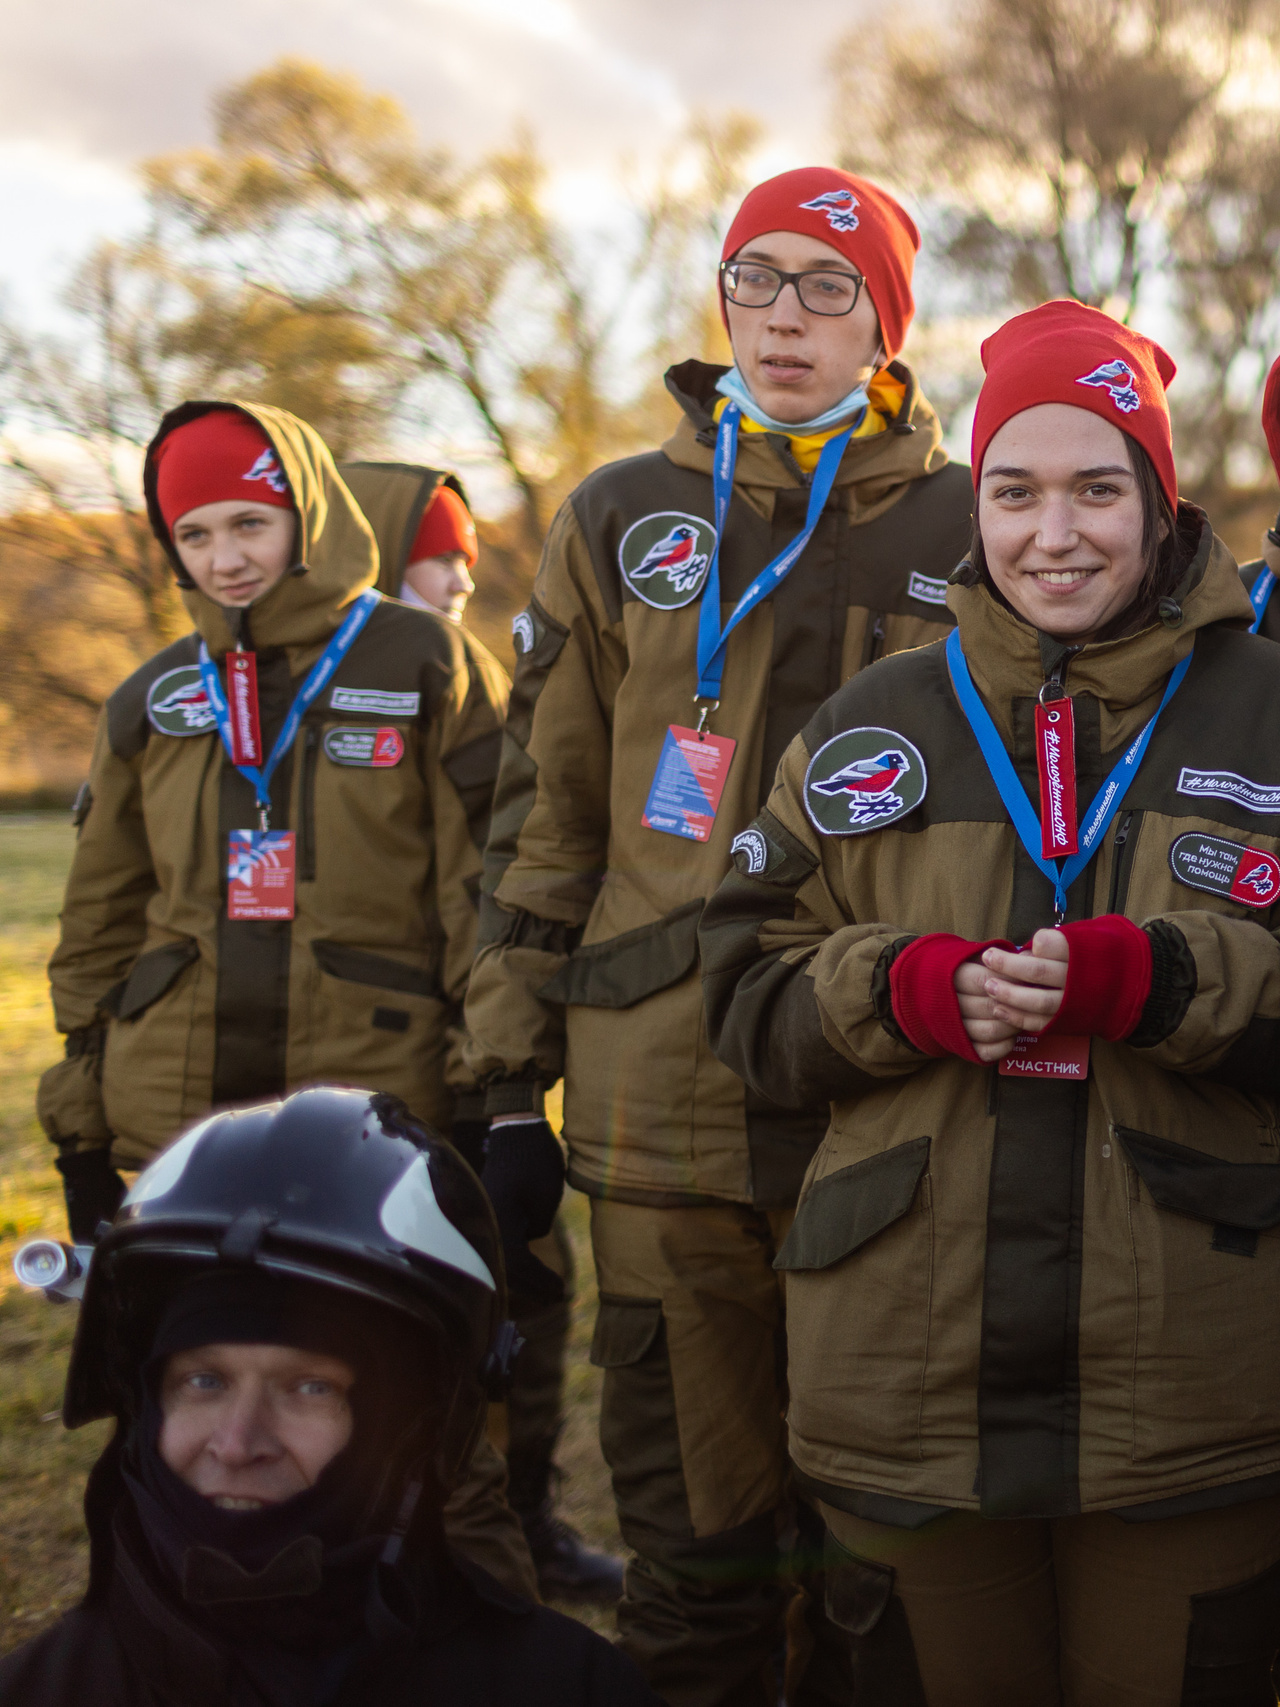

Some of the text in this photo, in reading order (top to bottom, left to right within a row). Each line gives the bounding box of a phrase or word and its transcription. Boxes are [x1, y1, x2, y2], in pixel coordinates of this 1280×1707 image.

[1178, 851, 1234, 873] где нужна
[1199, 844, 1239, 865] Мы там,
[1187, 865, 1231, 884] помощь
[1006, 1060, 1081, 1075] УЧАСТНИК
